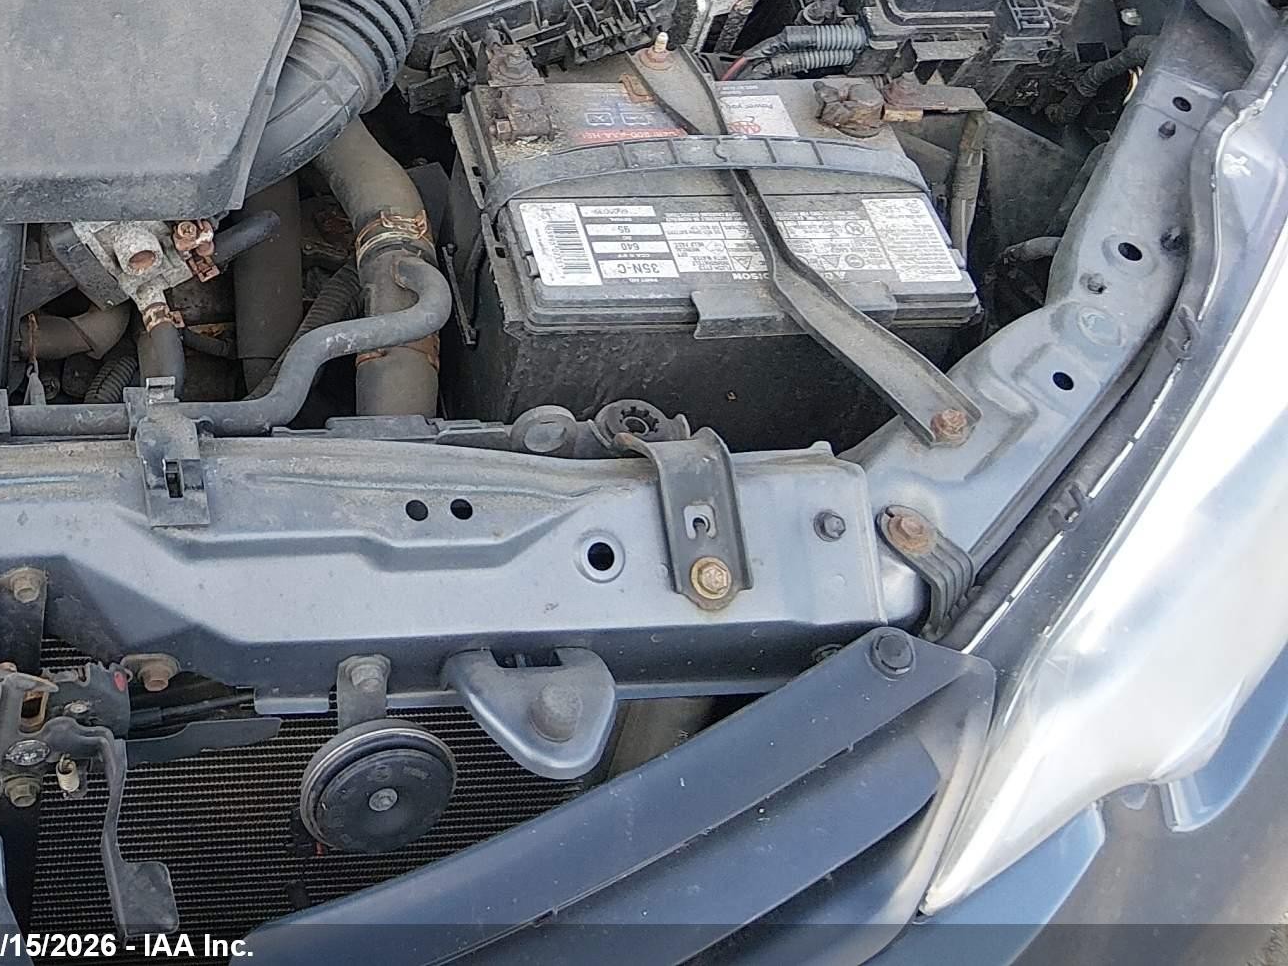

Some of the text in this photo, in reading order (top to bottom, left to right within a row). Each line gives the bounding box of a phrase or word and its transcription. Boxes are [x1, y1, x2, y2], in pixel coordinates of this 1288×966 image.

[617, 225, 631, 233] 95
[621, 242, 640, 251] 640
[617, 263, 660, 274] 35N-C
